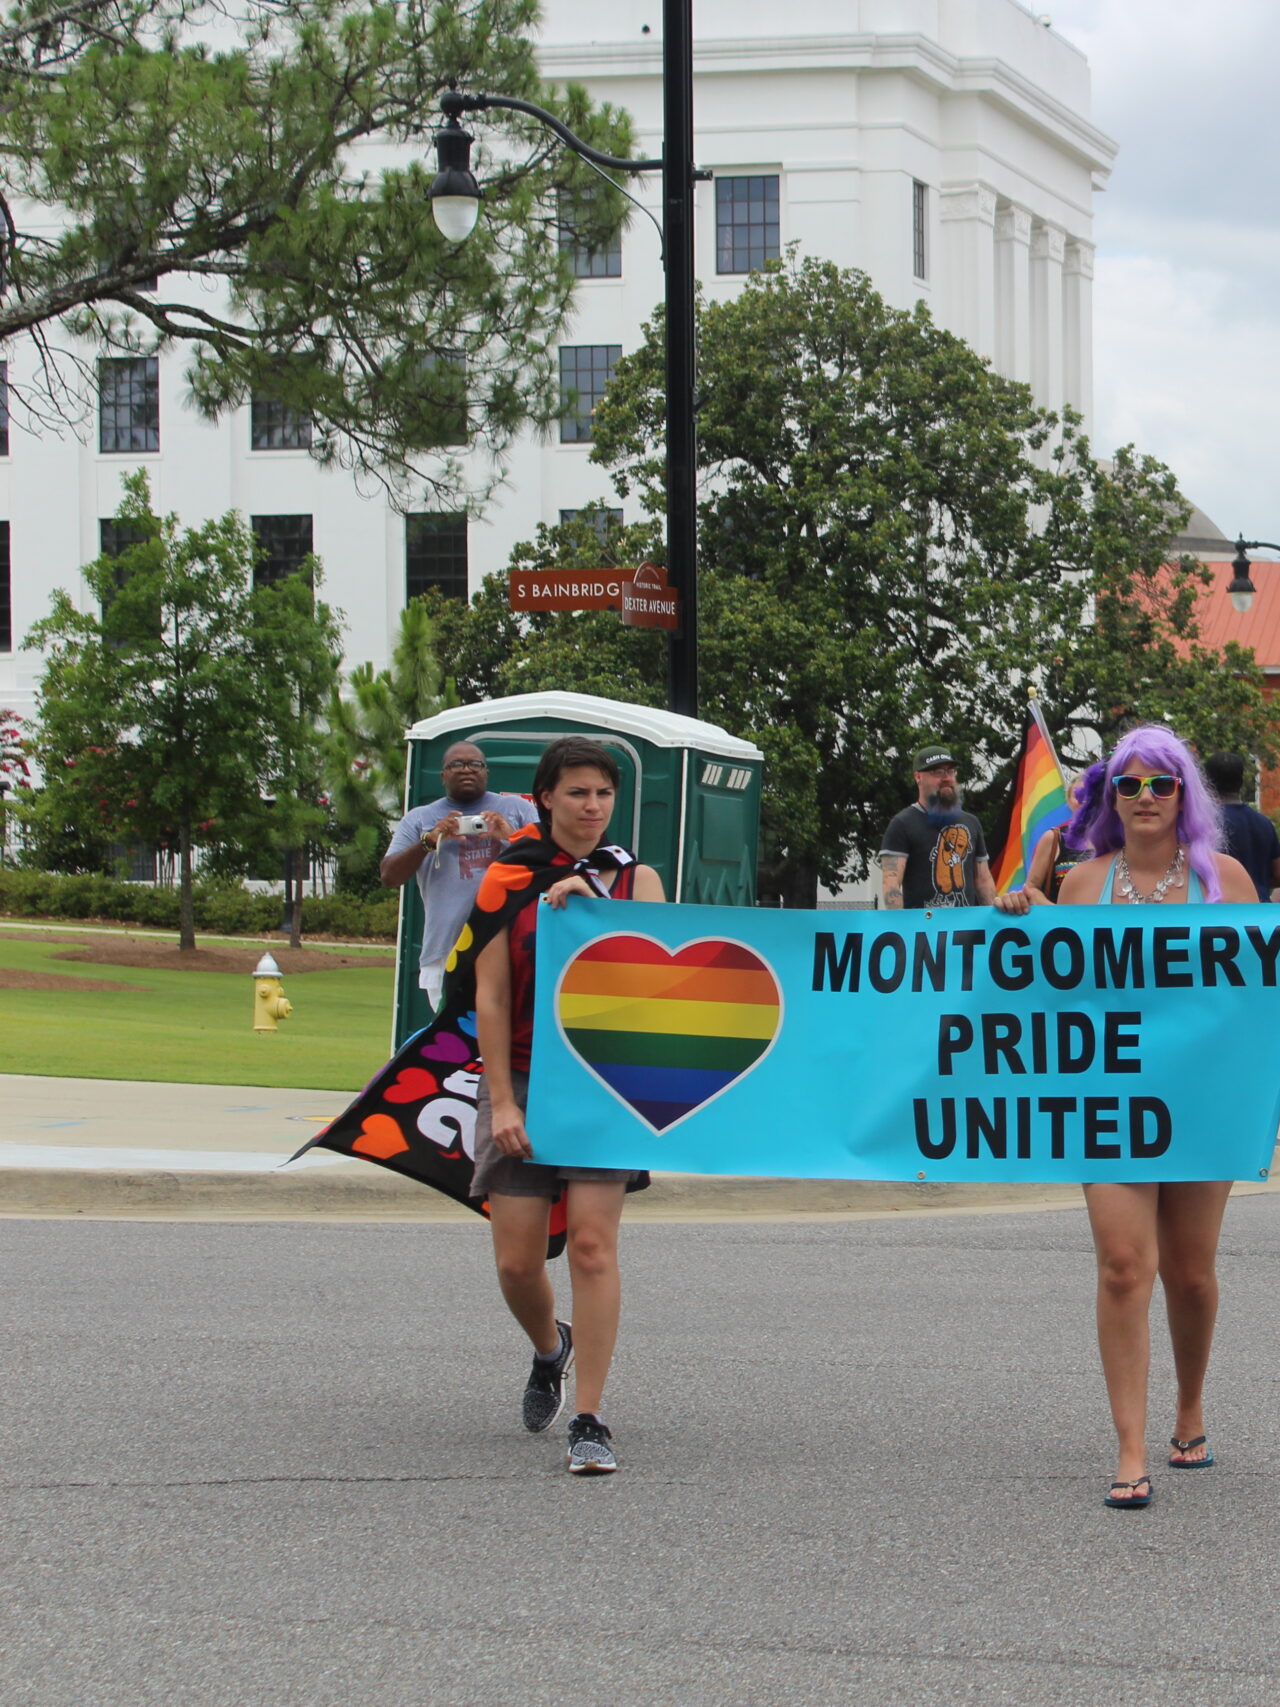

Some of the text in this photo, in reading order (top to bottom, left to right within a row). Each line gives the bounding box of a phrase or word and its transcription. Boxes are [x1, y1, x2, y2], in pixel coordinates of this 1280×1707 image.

[517, 582, 620, 598] S BAINBRIDG
[624, 596, 676, 616] DEXTER AVENUE
[925, 754, 941, 764] CASH
[464, 847, 492, 862] STATE
[937, 1011, 1142, 1076] PRIDE
[912, 1096, 1173, 1160] UNITED
